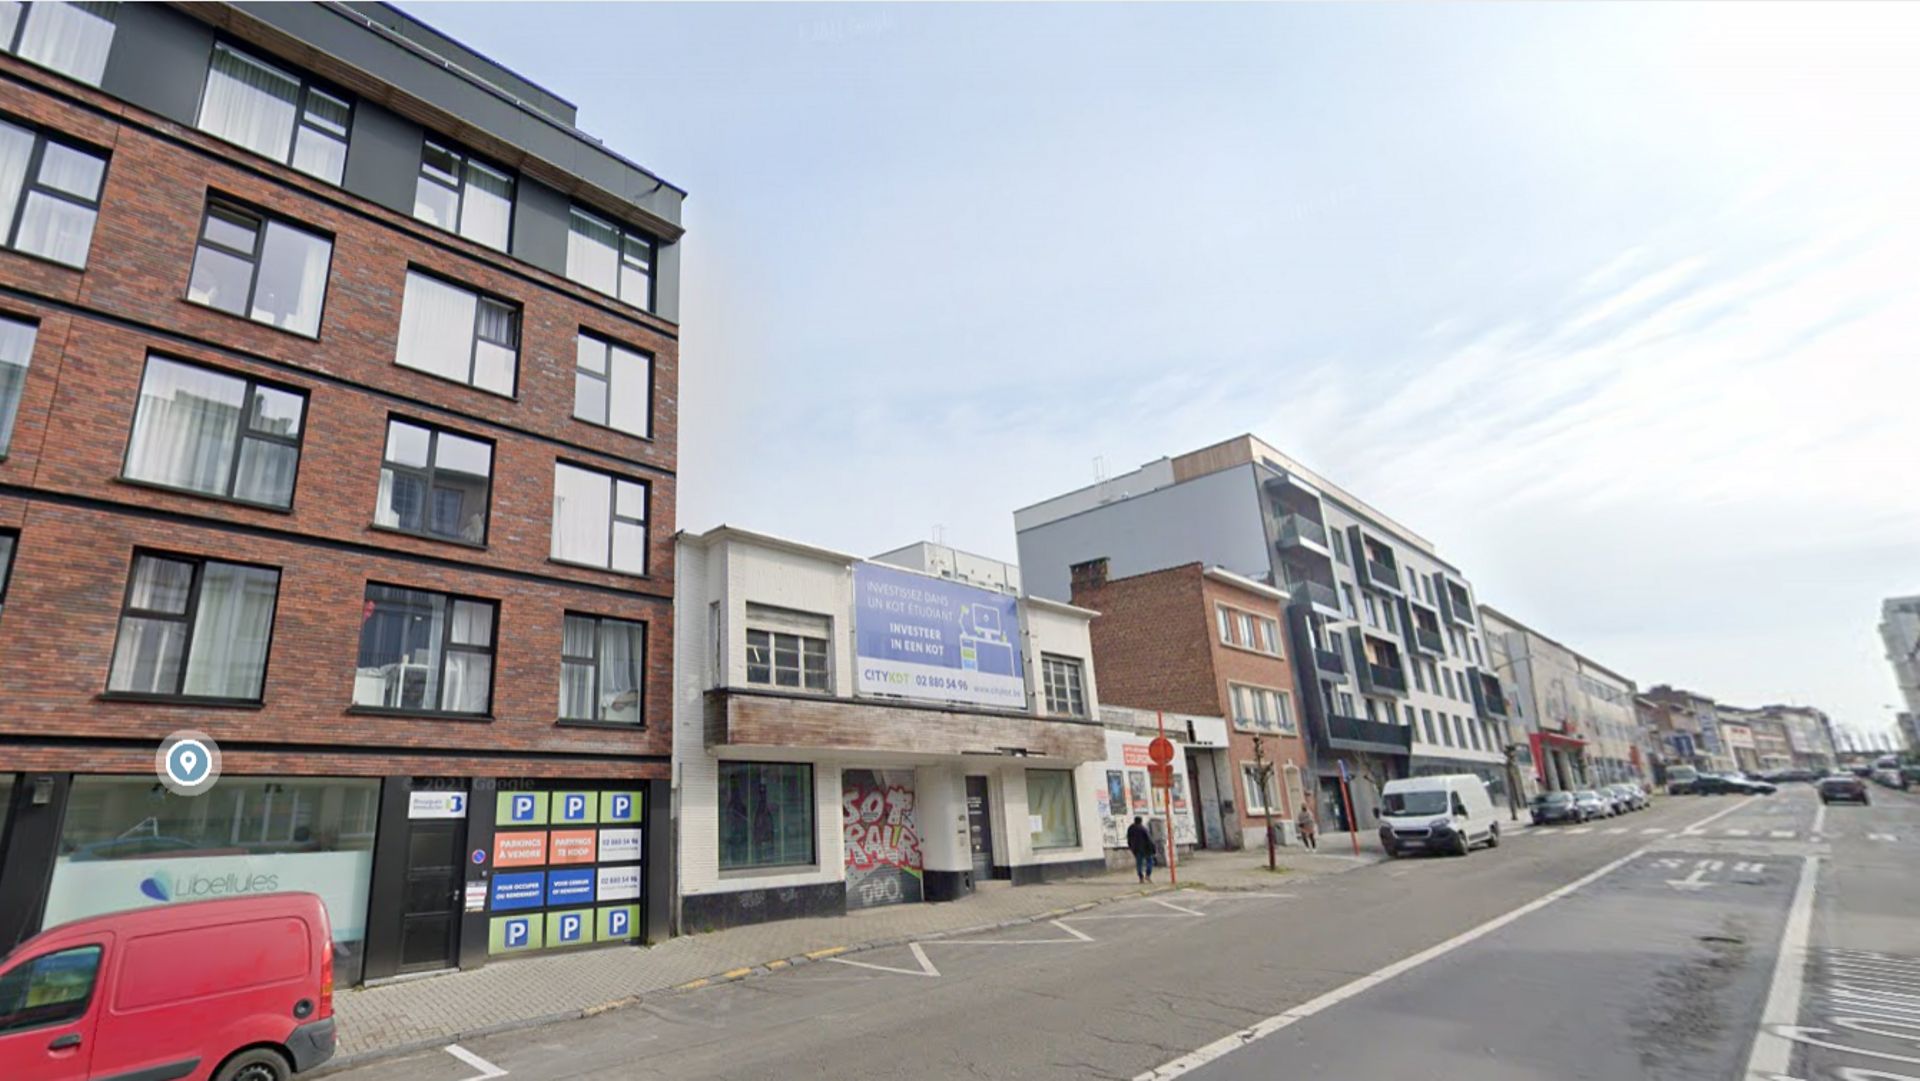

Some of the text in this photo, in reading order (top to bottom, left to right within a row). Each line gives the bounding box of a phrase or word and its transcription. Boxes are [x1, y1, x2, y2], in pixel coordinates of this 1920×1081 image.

[867, 582, 949, 607] INVESTISSEZ DANS
[868, 599, 883, 609] UN
[886, 601, 905, 614] KOT
[889, 623, 942, 641] INVESTEER
[891, 639, 944, 656] IN EEN KOT
[915, 674, 928, 687] 02
[516, 798, 532, 818] P
[569, 797, 583, 817] P
[616, 797, 629, 816] P
[175, 873, 279, 897] Libellules
[564, 917, 579, 939] P
[613, 913, 626, 933] P
[509, 922, 525, 945] P
